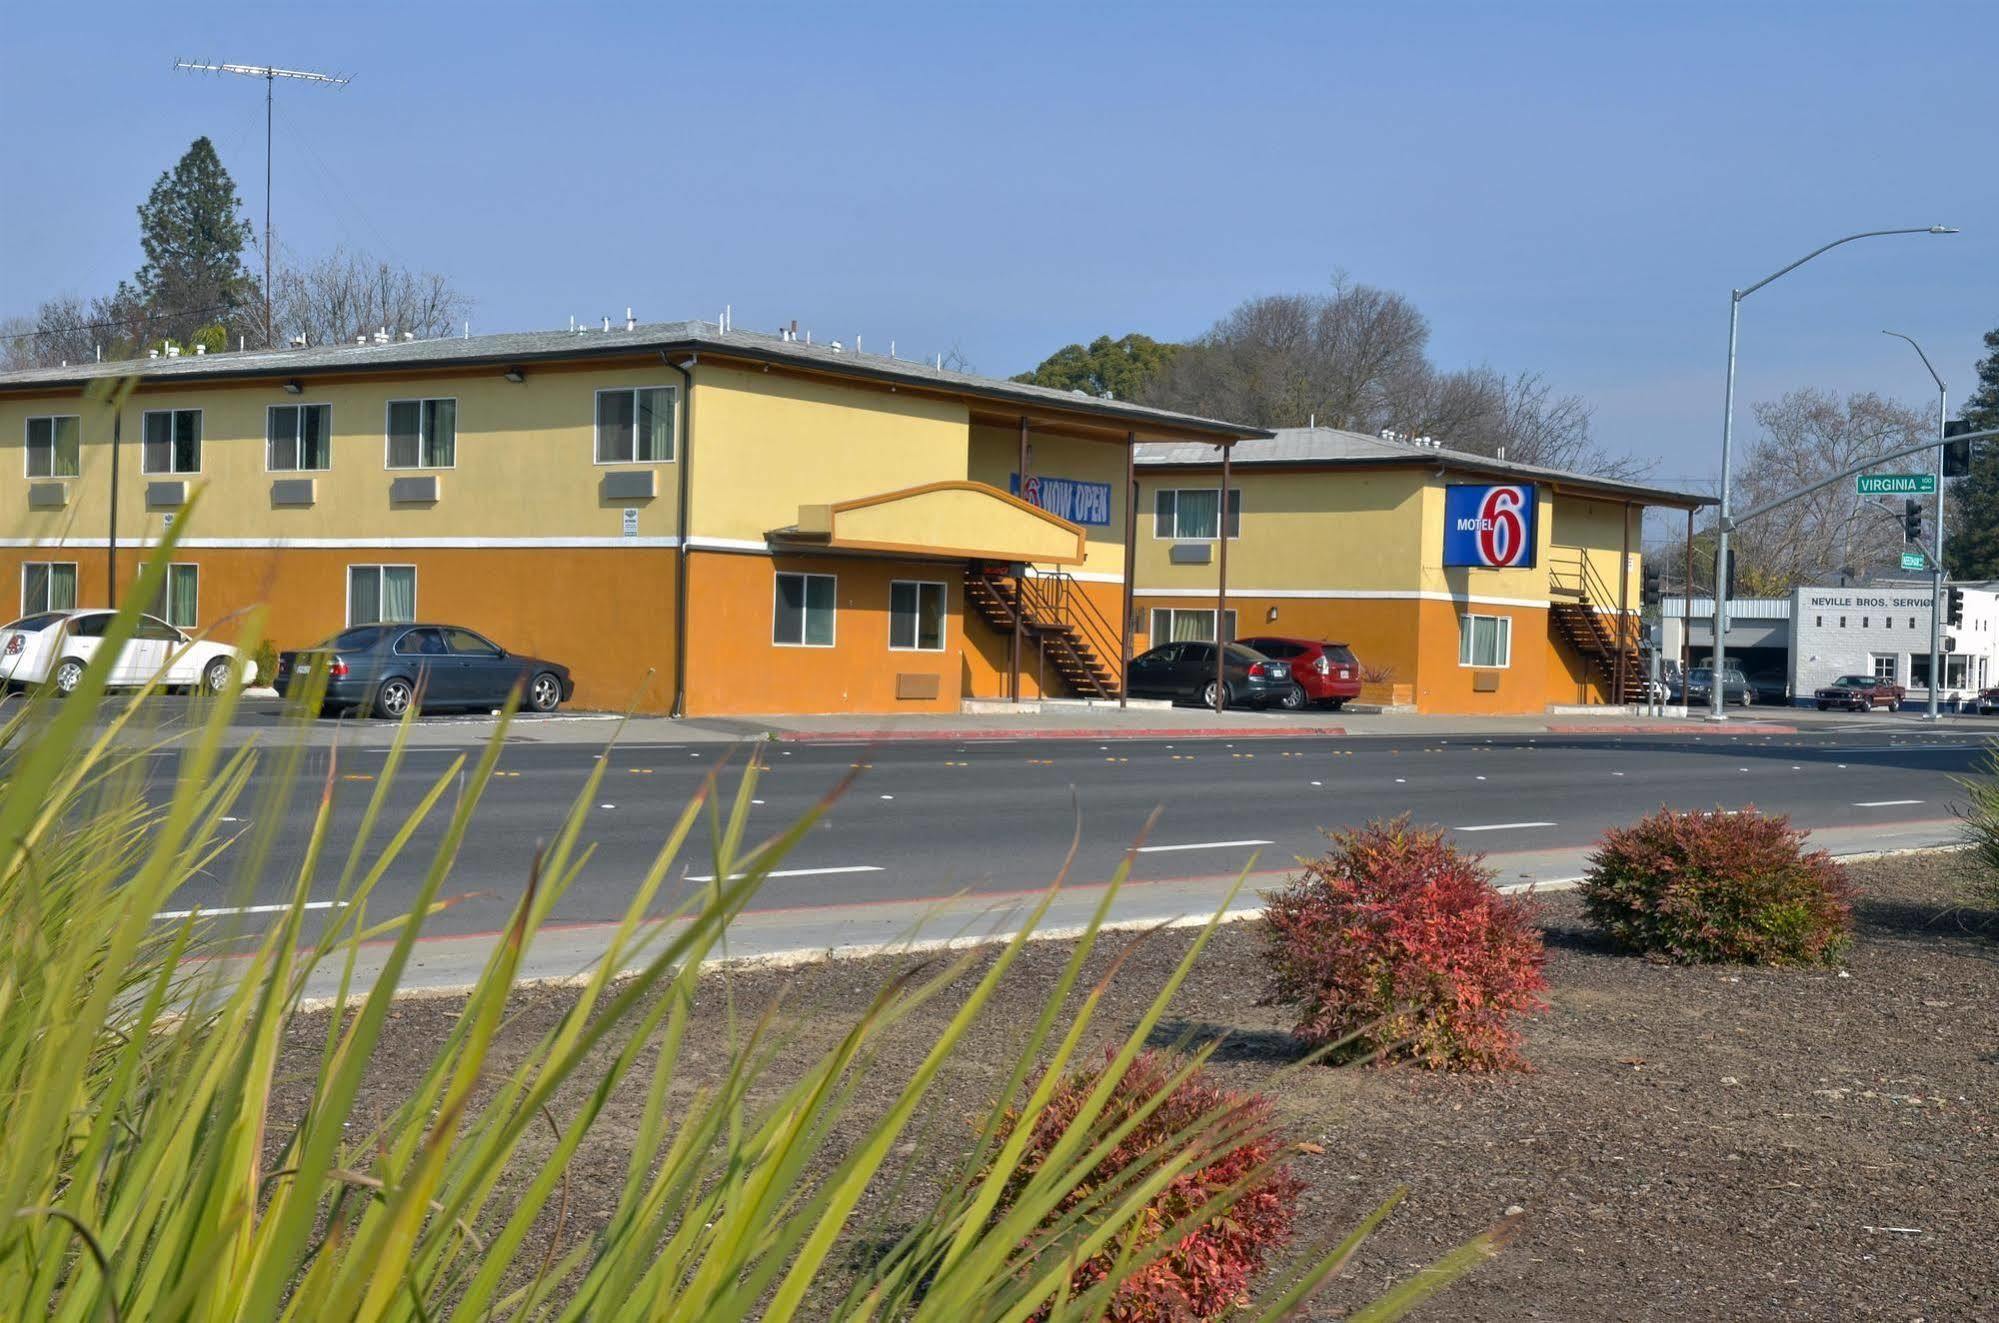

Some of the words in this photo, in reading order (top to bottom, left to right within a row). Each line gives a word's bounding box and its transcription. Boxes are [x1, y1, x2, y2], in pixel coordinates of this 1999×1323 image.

[1861, 478, 1917, 492] VIRGINIA
[1043, 480, 1073, 519] NOW
[1075, 483, 1107, 522] OPEN
[1457, 518, 1494, 532] MOTEL
[1479, 487, 1523, 567] 6
[1811, 597, 1851, 607] NEVILLE
[1857, 598, 1888, 608] BROS.
